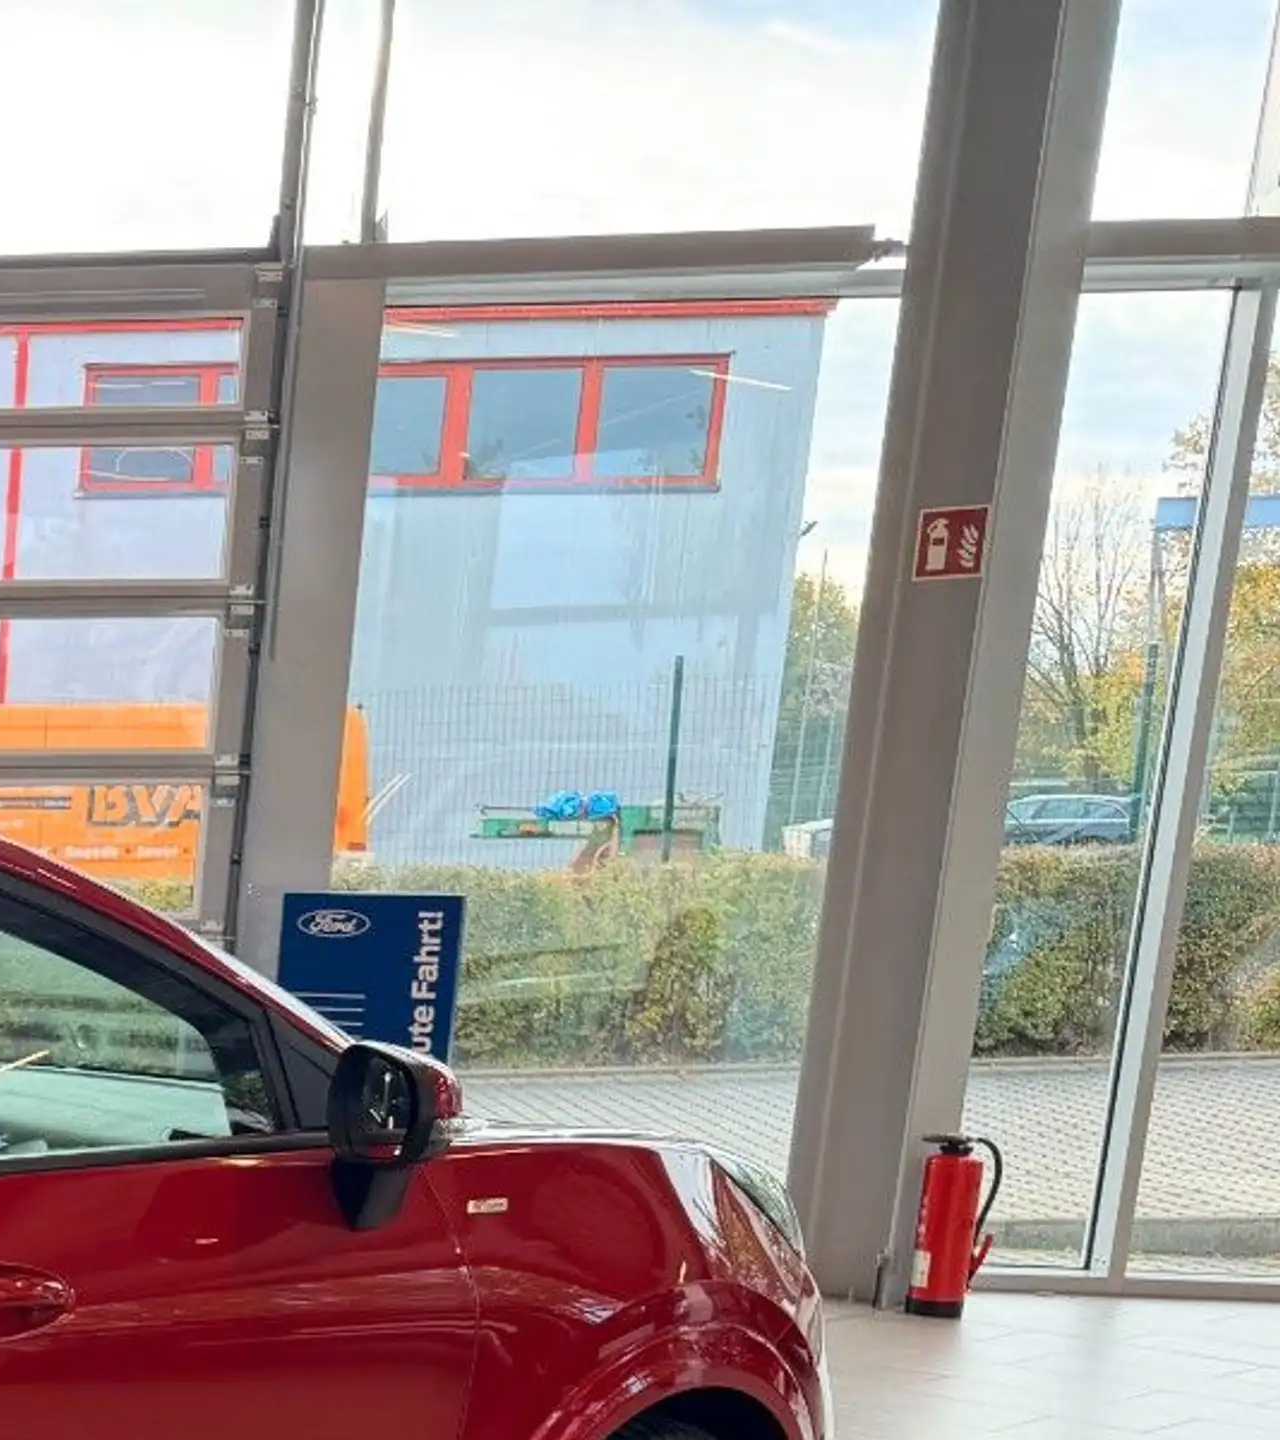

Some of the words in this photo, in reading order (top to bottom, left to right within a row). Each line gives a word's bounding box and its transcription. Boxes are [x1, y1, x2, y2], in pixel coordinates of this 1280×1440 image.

[306, 910, 362, 934] Ford
[411, 911, 444, 1000] Fahrt!
[408, 1004, 435, 1054] ute
